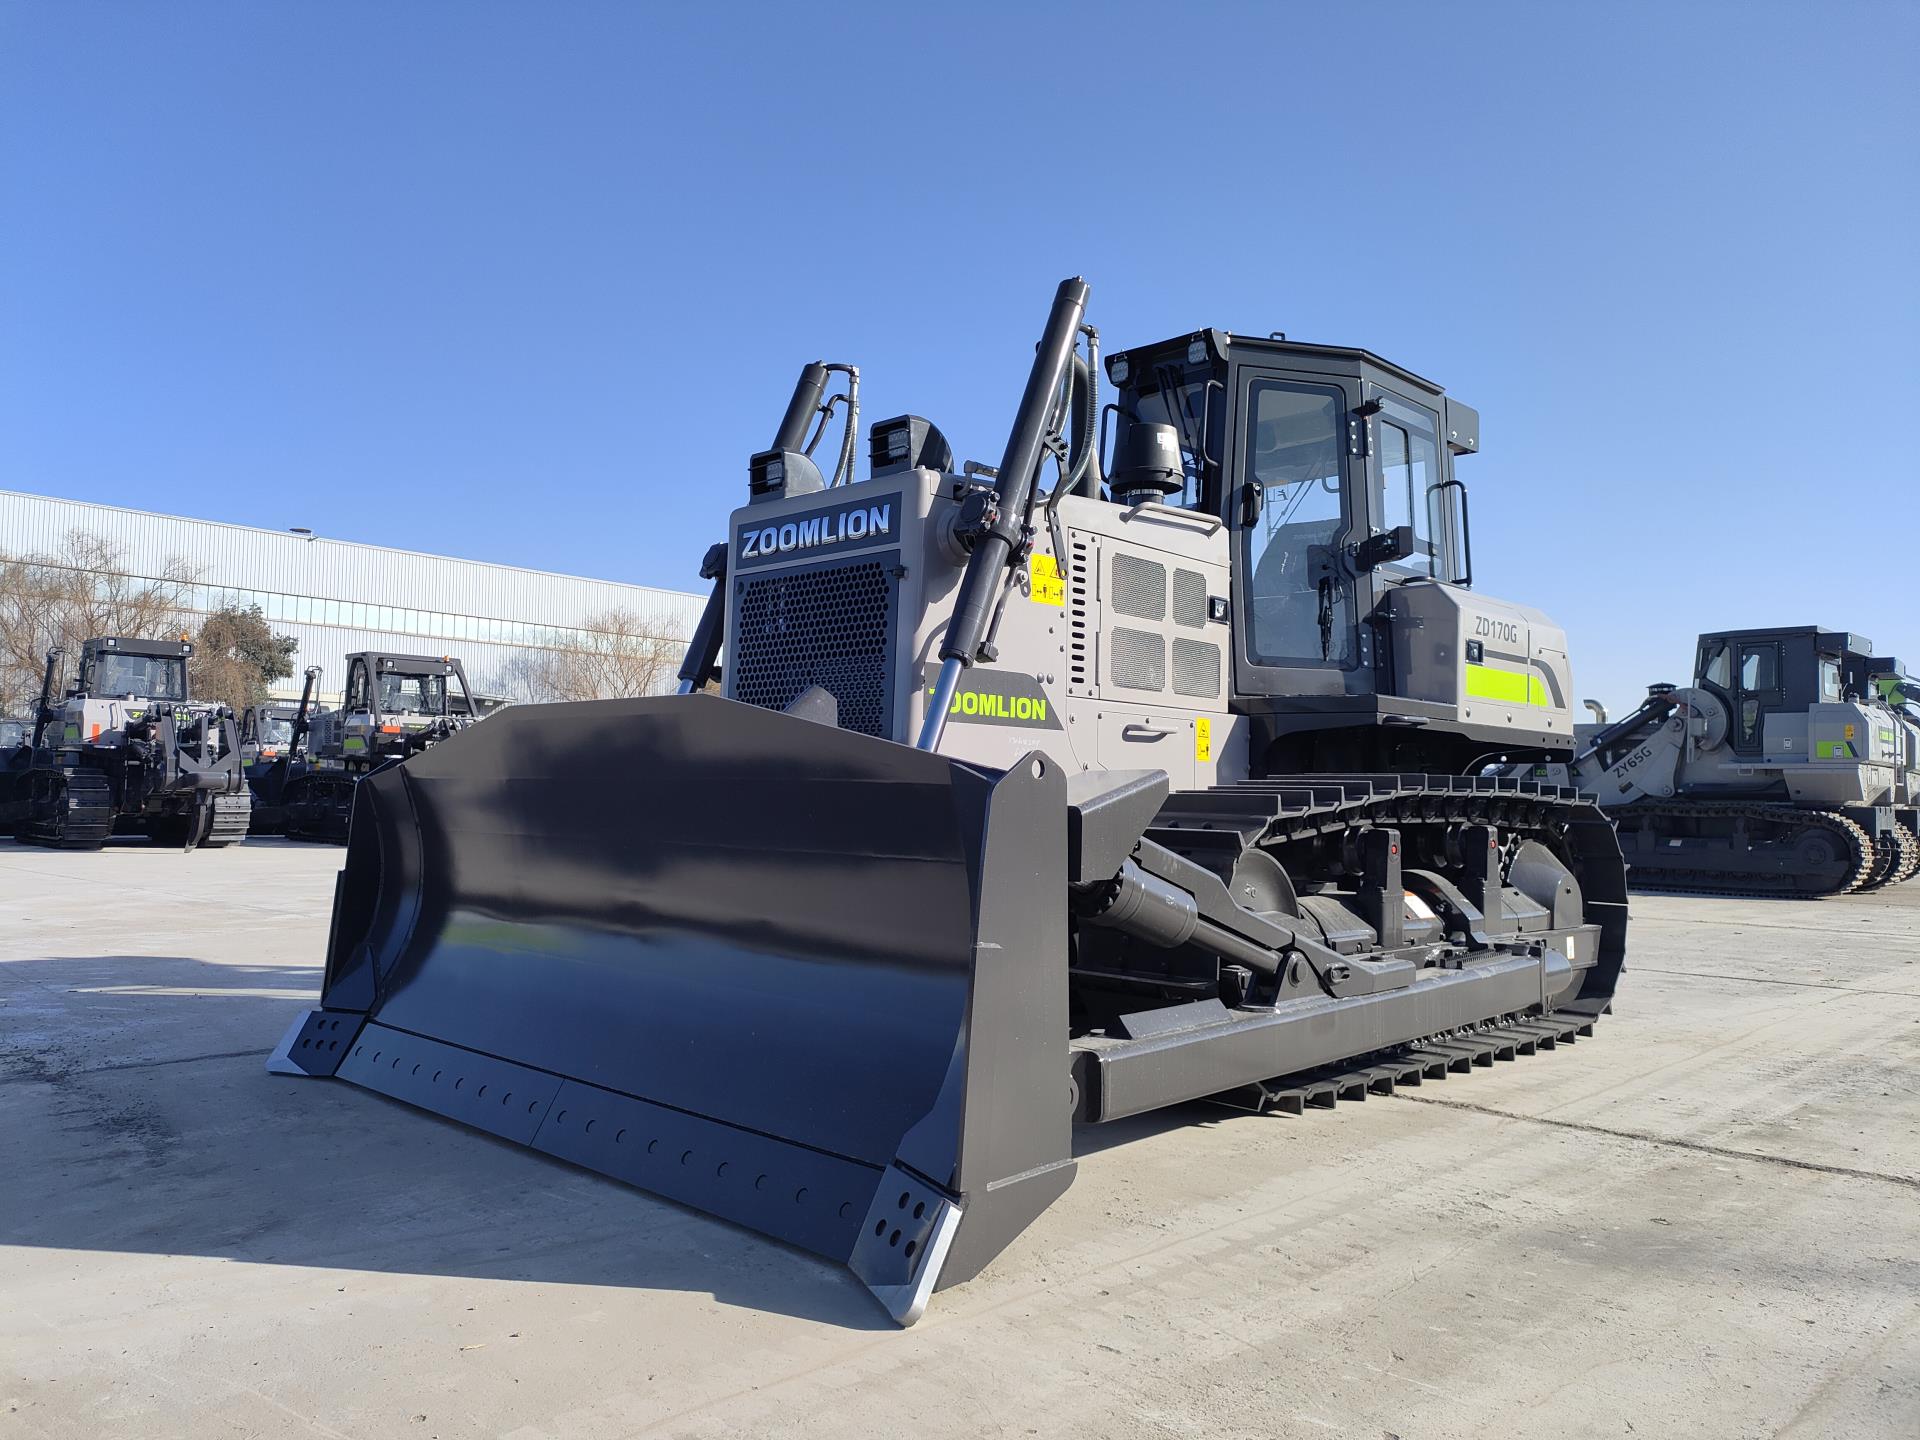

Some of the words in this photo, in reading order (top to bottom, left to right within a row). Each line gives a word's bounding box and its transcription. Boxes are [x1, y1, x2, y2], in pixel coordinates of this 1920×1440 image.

[742, 503, 891, 559] ZOOMLION
[1475, 615, 1517, 644] ZD170G
[929, 688, 1046, 721] OOMLION
[1613, 746, 1652, 778] ZY65G
